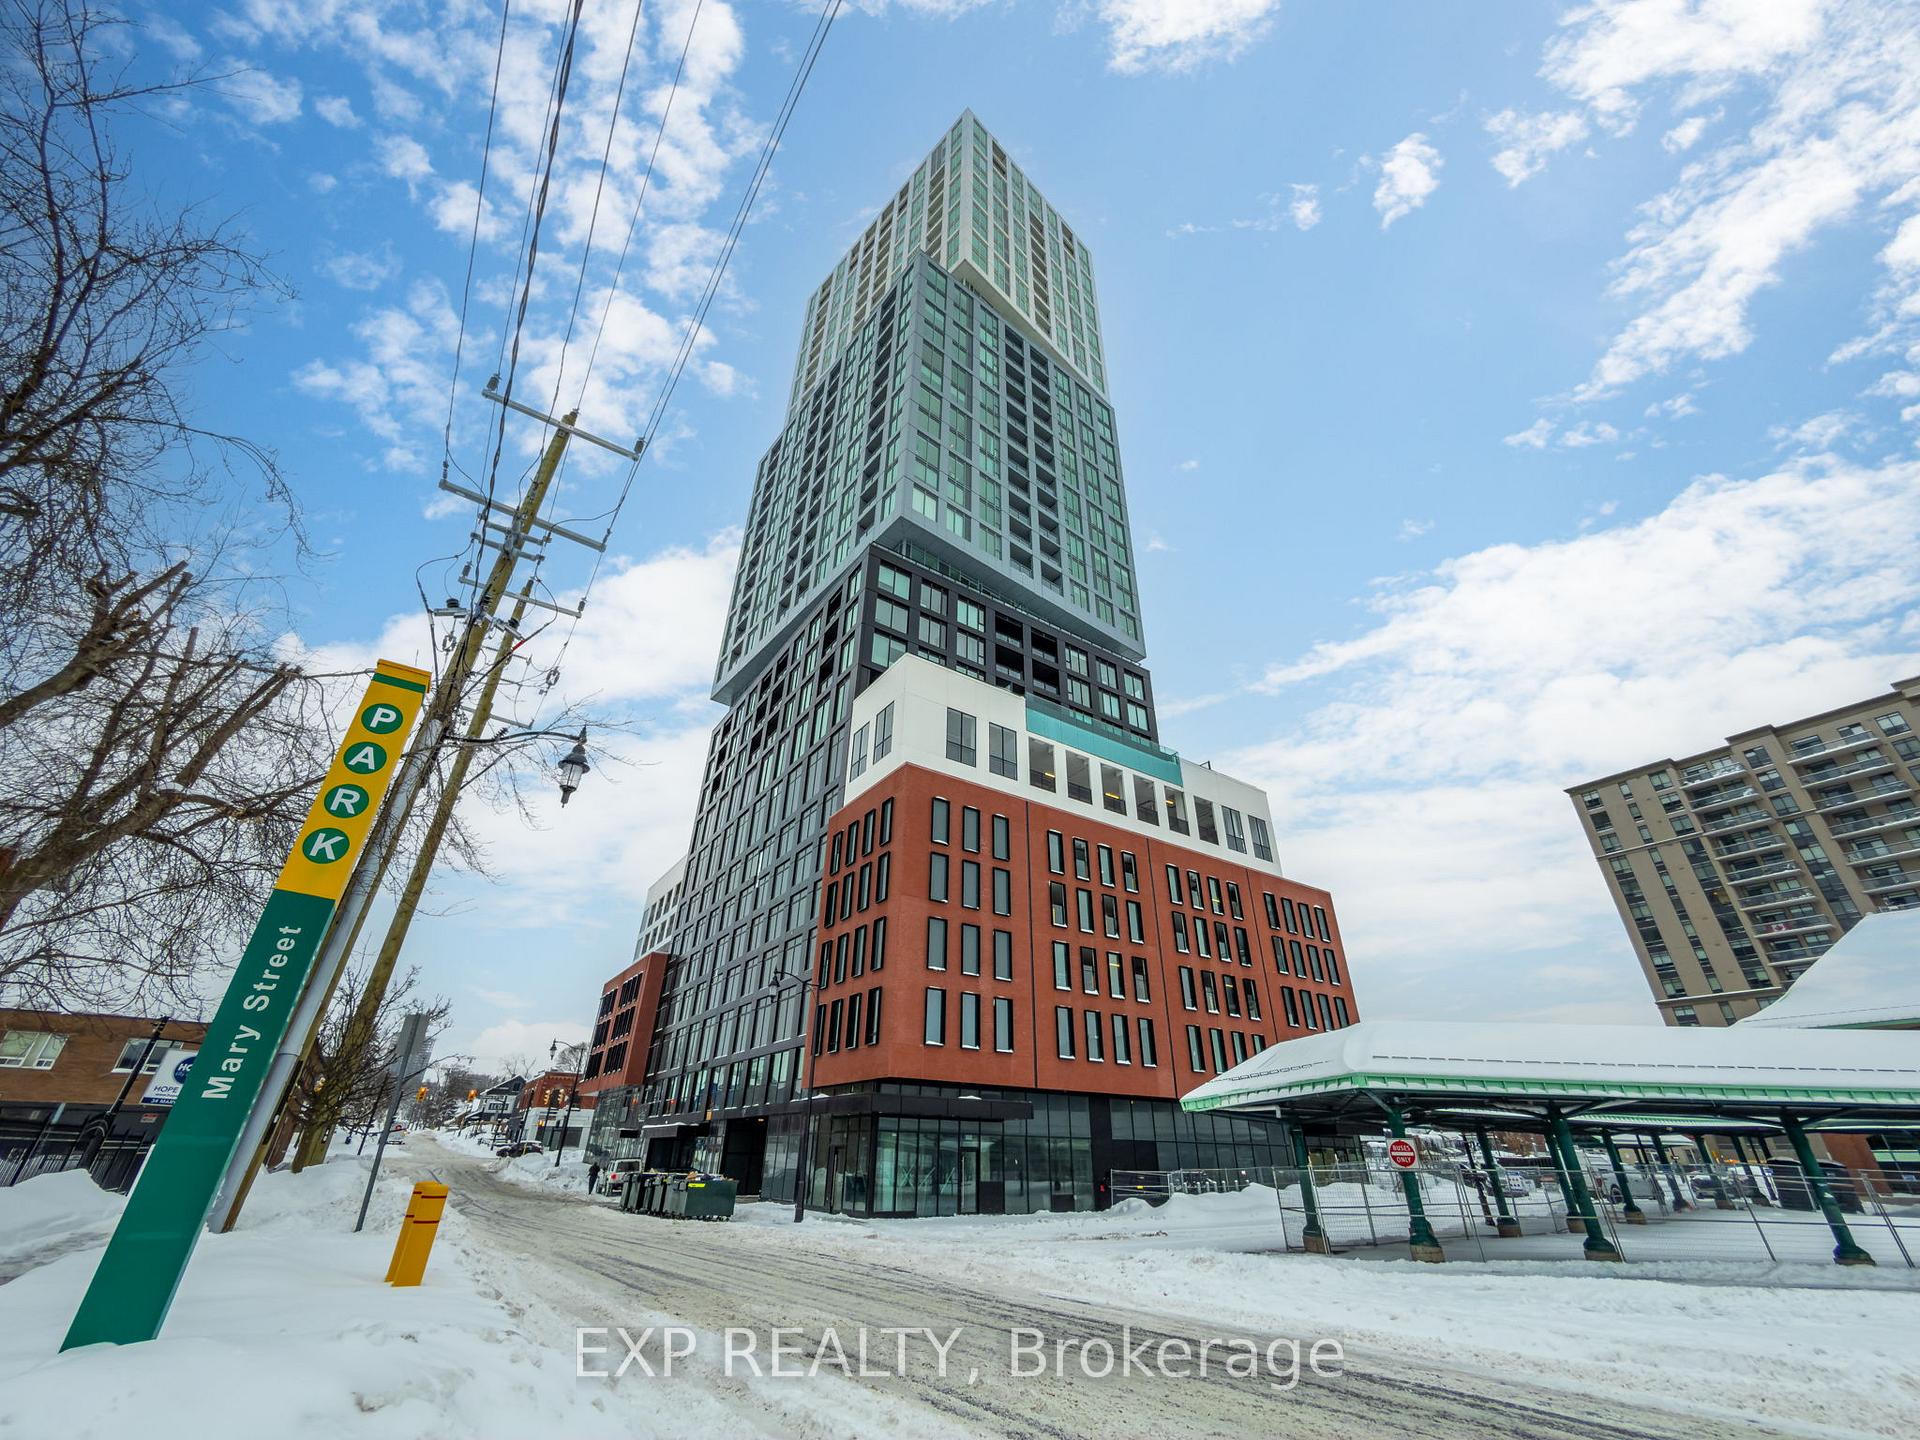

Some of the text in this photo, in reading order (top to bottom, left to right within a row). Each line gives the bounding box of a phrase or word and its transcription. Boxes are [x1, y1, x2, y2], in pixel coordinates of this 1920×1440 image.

[309, 707, 397, 861] PARK
[201, 925, 302, 1099] Mary Street
